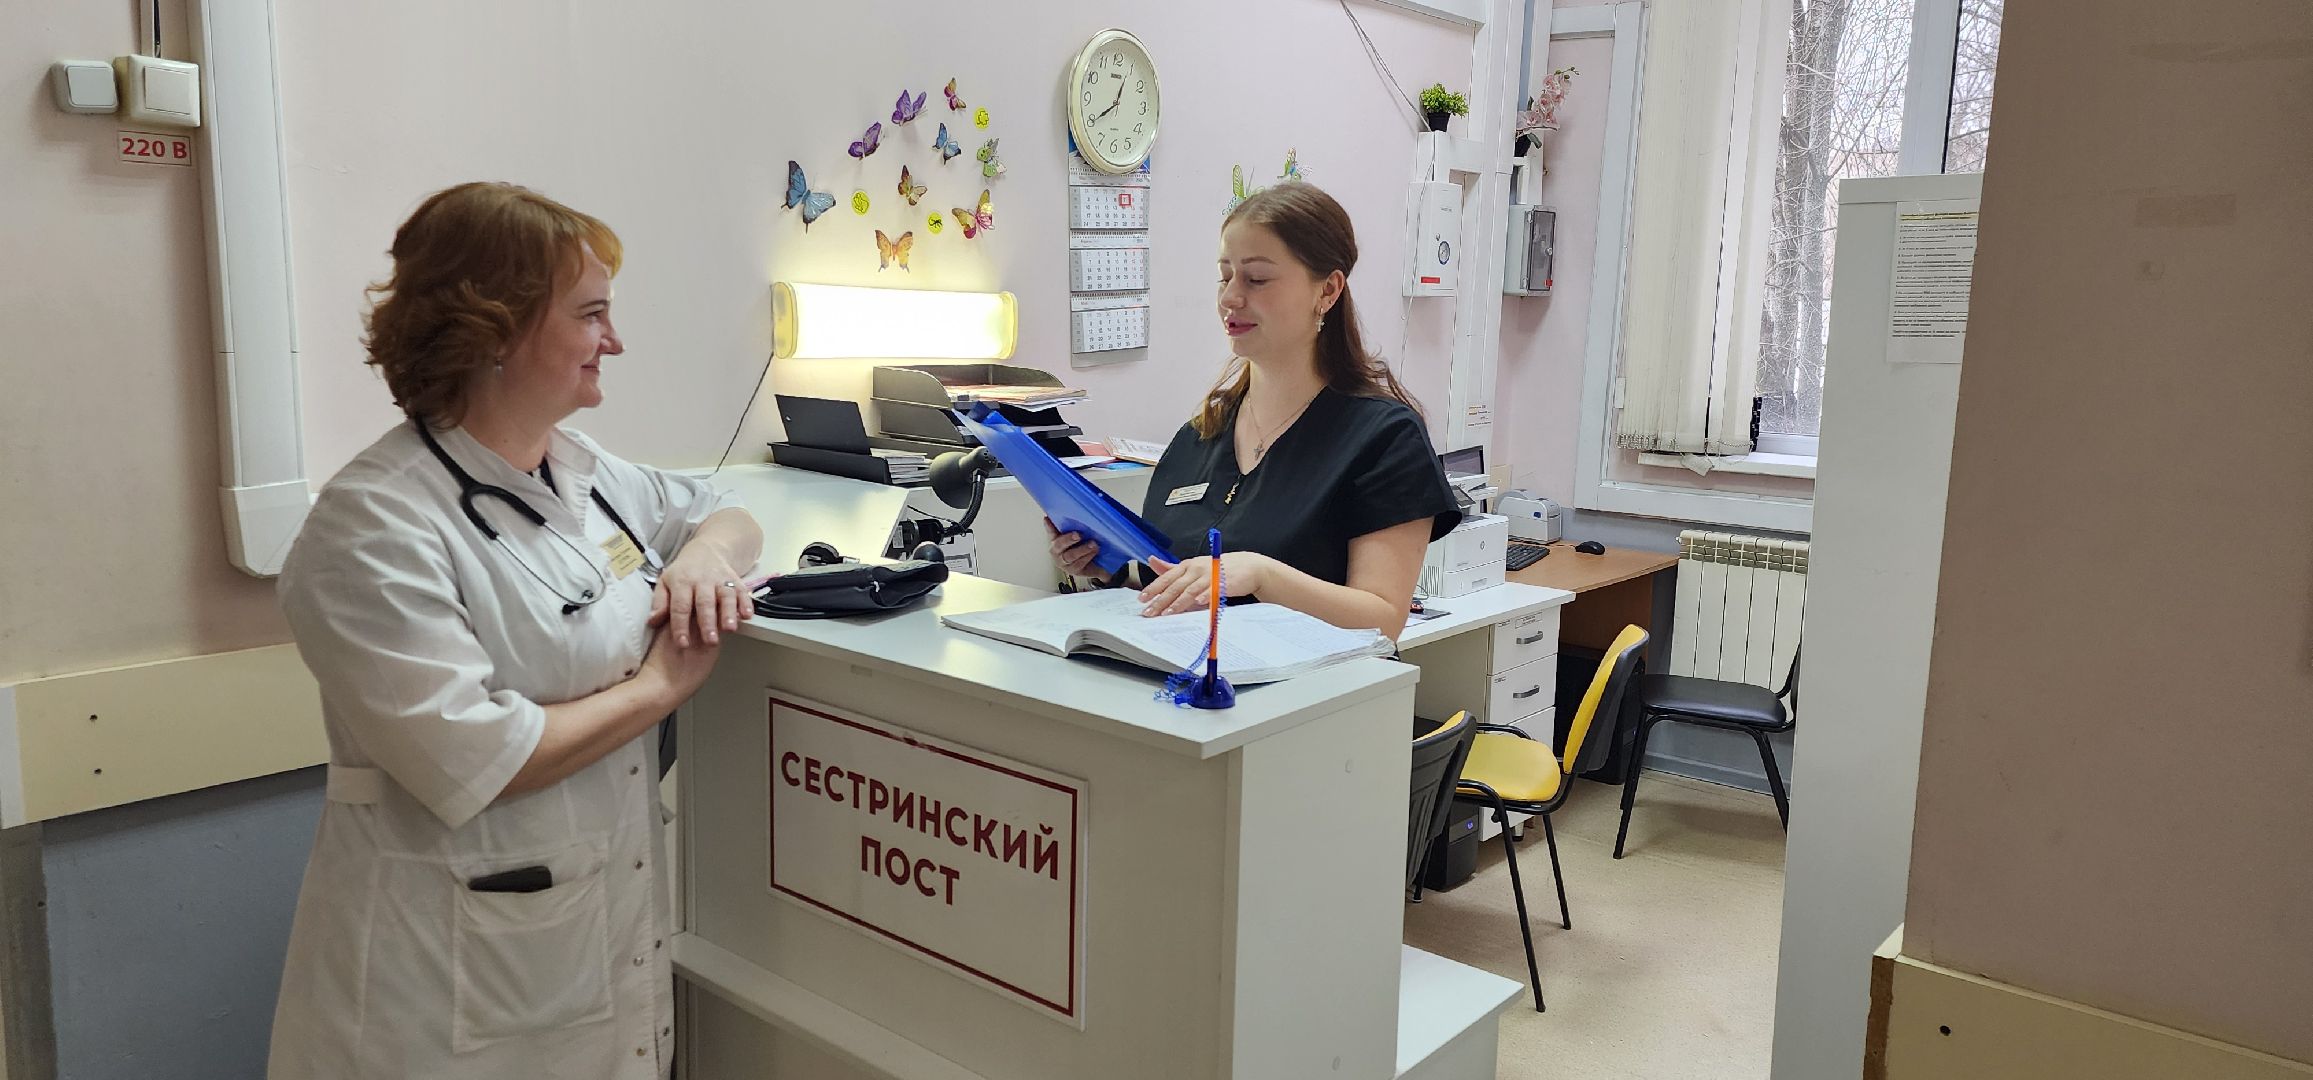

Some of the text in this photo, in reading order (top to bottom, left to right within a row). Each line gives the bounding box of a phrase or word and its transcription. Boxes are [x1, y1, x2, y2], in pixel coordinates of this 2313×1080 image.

[1099, 55, 1109, 69] 11
[1113, 52, 1124, 67] 12
[1130, 60, 1136, 76] 1
[1087, 71, 1099, 85] 10
[1136, 80, 1144, 94] 2
[1084, 91, 1092, 107] 9
[1138, 101, 1147, 116] 3
[1086, 113, 1096, 128] 8
[1133, 122, 1143, 135] 4
[1097, 132, 1106, 147] 7
[1109, 139, 1118, 154] 6
[1123, 137, 1132, 150] 5
[122, 137, 188, 159] 220 В
[781, 751, 1060, 881] СЕСТРИНСКИЙ
[861, 834, 961, 906] ПОСТ
